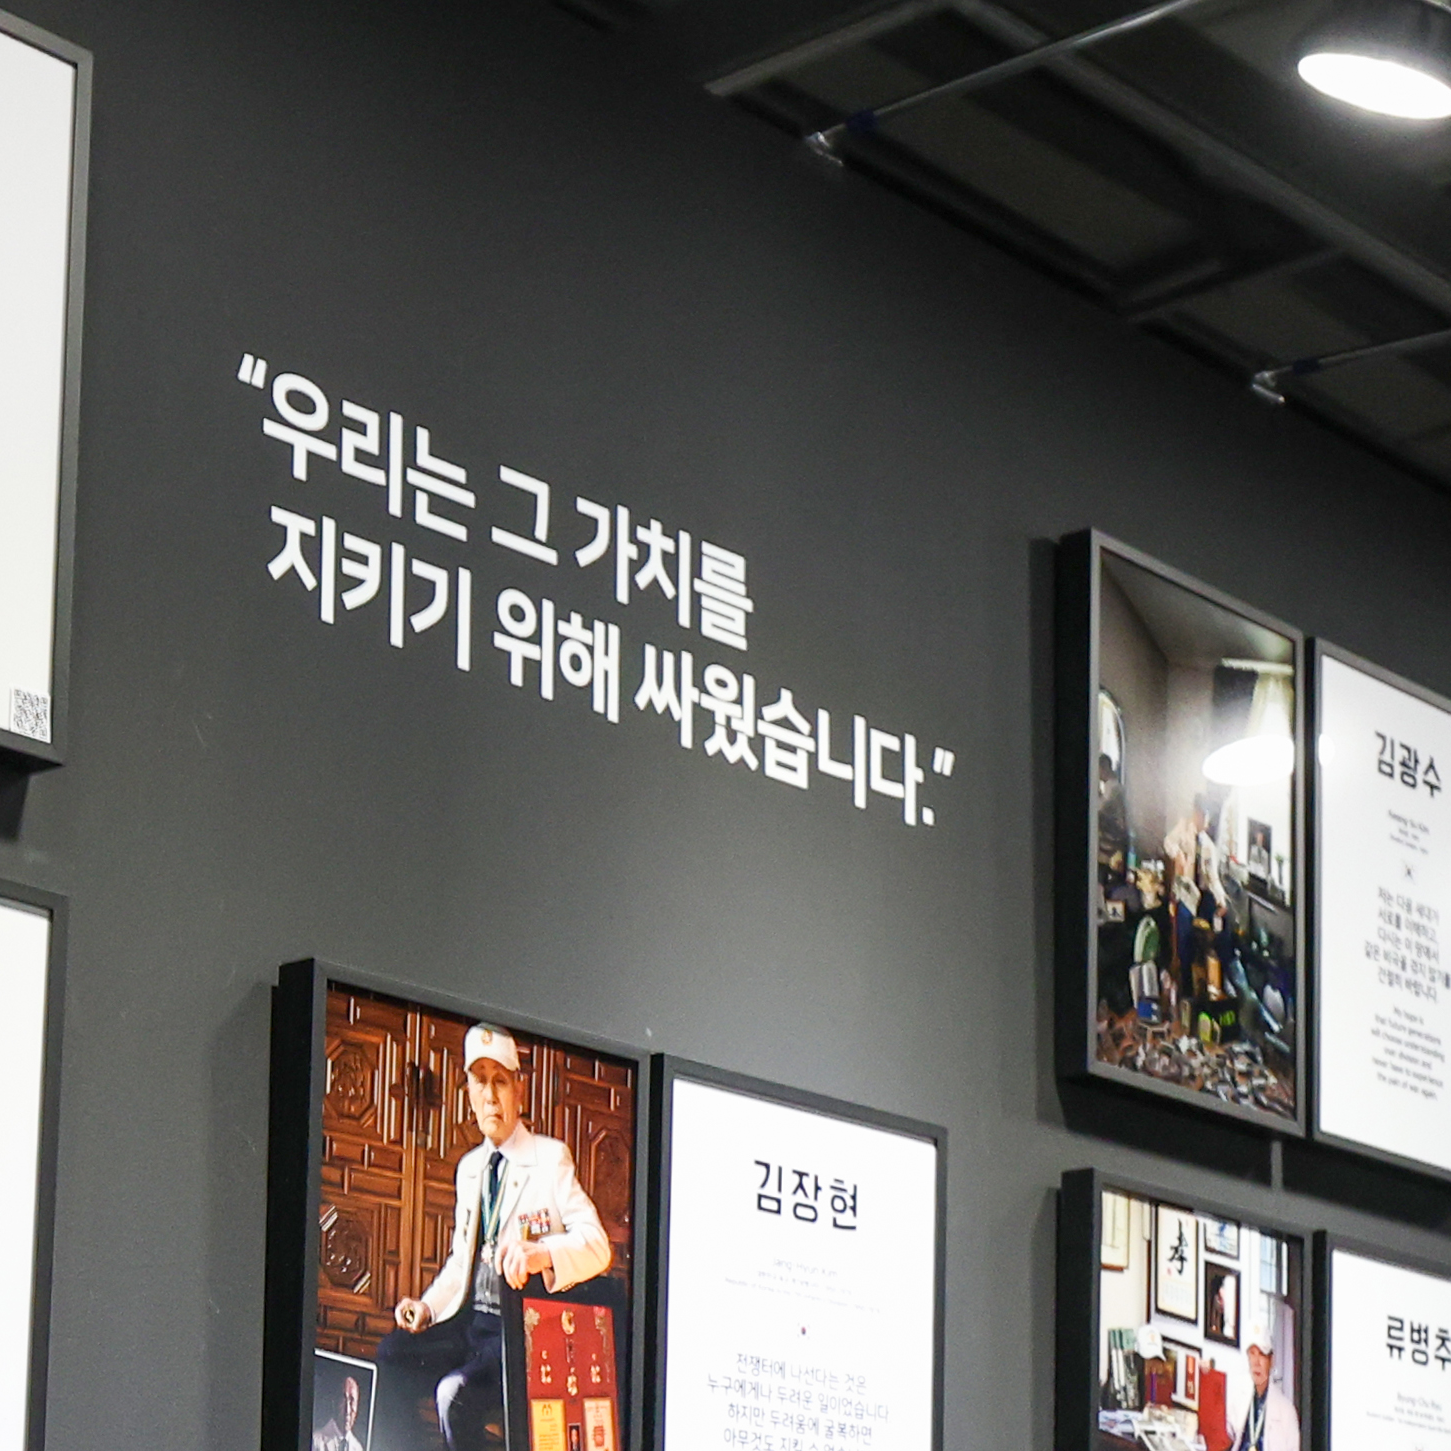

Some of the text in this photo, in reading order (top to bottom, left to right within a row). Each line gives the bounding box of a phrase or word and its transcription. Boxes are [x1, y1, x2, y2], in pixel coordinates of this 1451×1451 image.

[267, 502, 472, 672] 지키기
[493, 588, 620, 724] 위해
[491, 465, 558, 566] 그
[572, 496, 754, 652] 가치를
[1376, 732, 1442, 797] 김광수
[753, 1159, 858, 1231] 김장현
